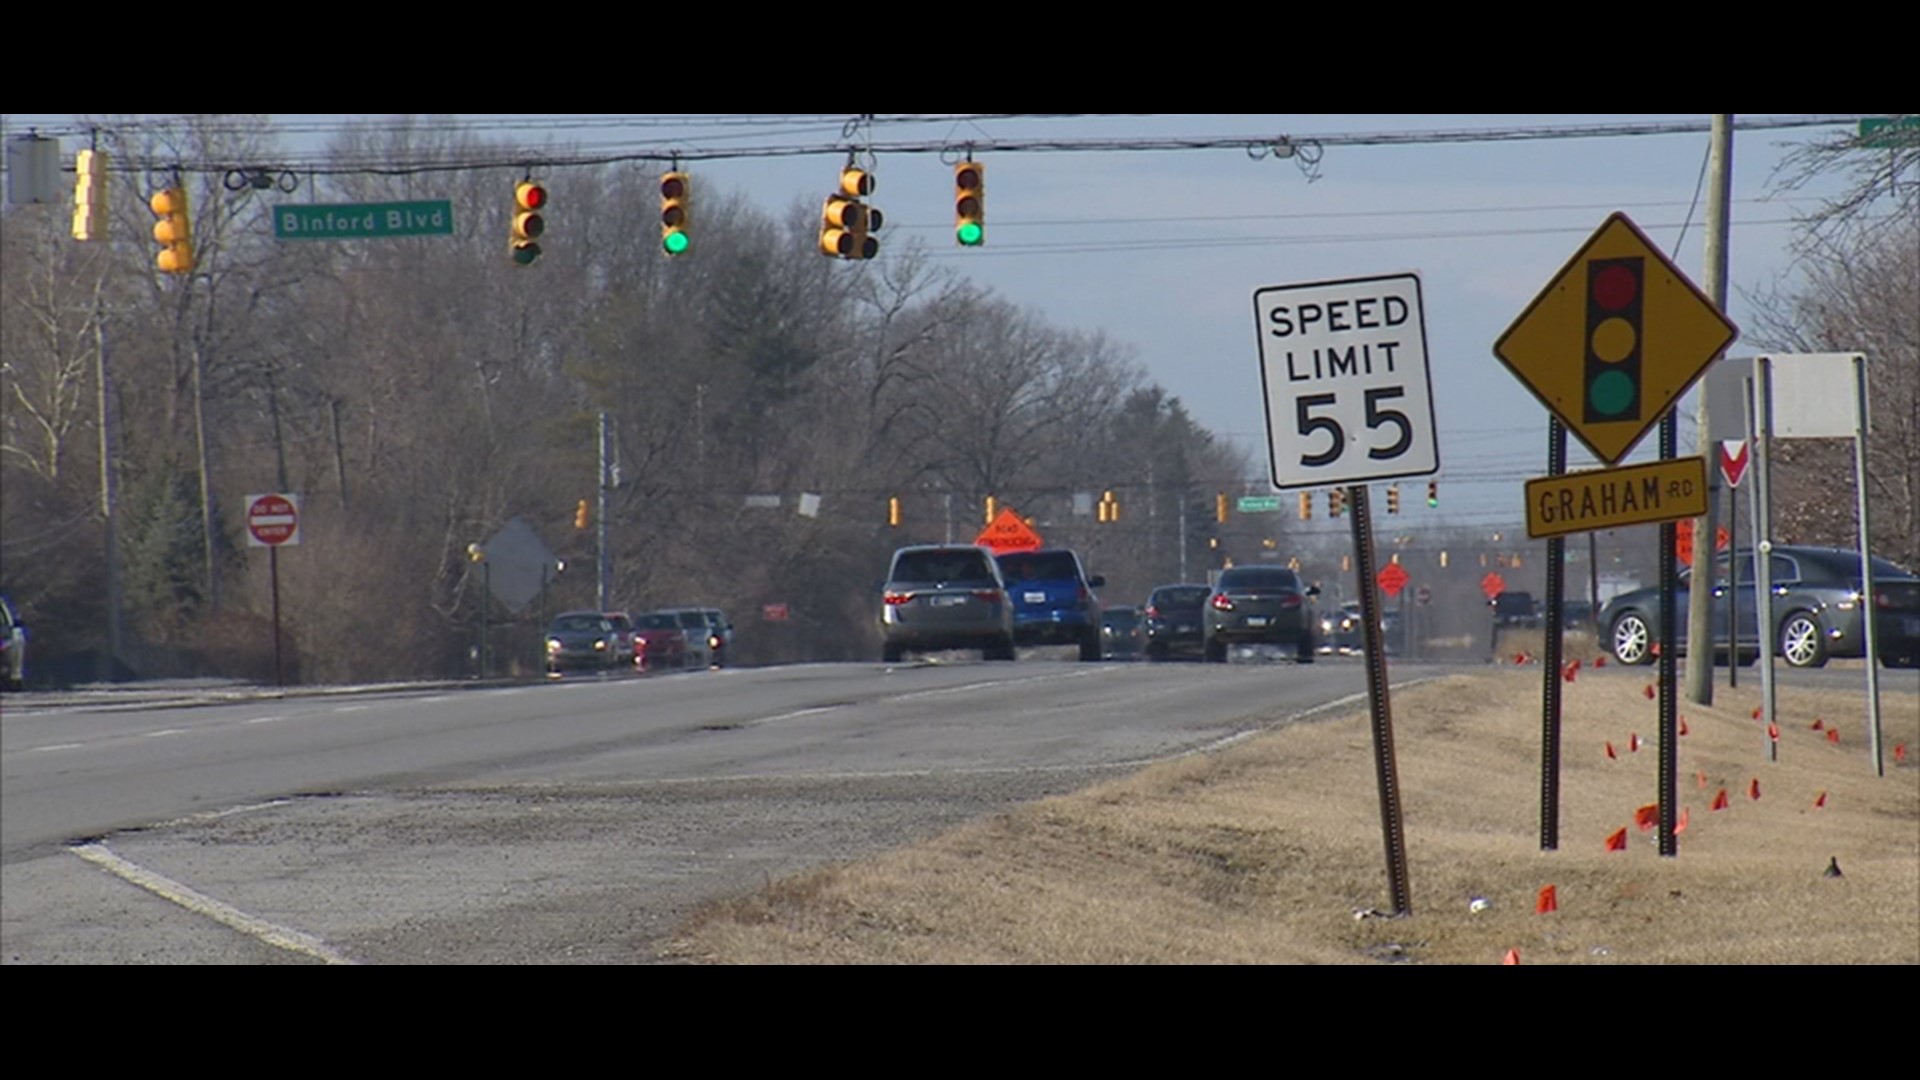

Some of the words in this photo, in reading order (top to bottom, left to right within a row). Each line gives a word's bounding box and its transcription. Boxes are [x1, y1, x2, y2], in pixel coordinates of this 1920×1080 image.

[283, 212, 375, 232] Binford
[387, 208, 443, 228] Blvd
[1270, 296, 1408, 337] SPEED
[1286, 341, 1400, 381] LIMIT
[1296, 385, 1413, 467] 55
[1539, 476, 1660, 523] GRAHAM
[1669, 479, 1693, 498] RD
